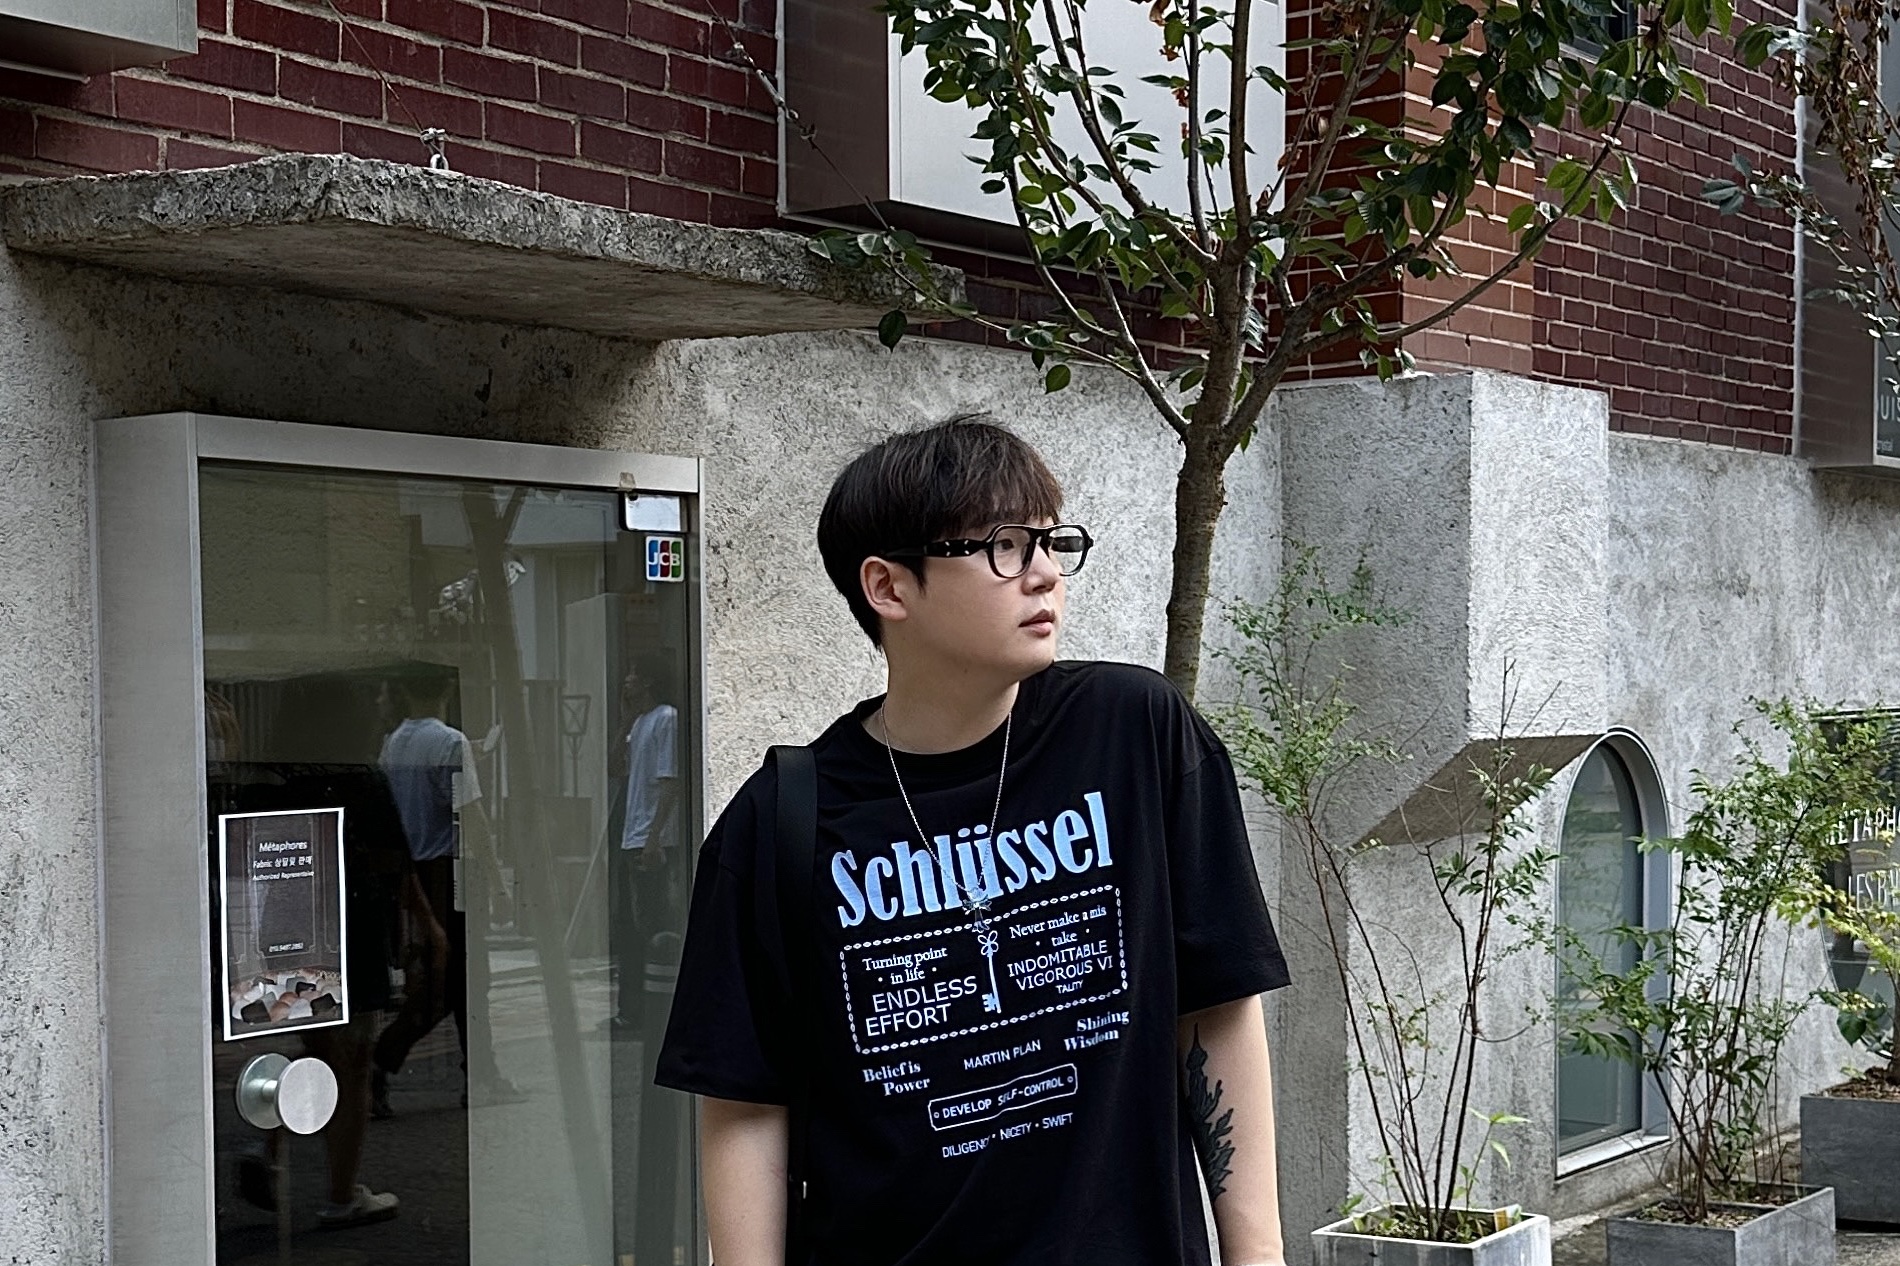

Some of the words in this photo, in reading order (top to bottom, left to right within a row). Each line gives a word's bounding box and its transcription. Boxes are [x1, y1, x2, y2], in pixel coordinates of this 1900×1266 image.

[648, 551, 681, 566] JCB
[831, 791, 1113, 928] Schlüssel
[1009, 919, 1046, 939] Never
[1047, 911, 1080, 930] make
[1082, 911, 1089, 921] a
[1089, 904, 1107, 919] mis
[1051, 931, 1078, 947] take
[861, 953, 914, 971] Turning
[914, 947, 948, 968] point
[1006, 939, 1108, 978] INDOMITABLE
[890, 972, 904, 985] in
[904, 966, 926, 983] life
[1016, 959, 1093, 991] VIGOROUS
[1097, 955, 1113, 971] VI
[872, 975, 978, 1013] ENDLESS
[1055, 979, 1084, 994] TALITY
[865, 1002, 952, 1037] EFFORT
[1076, 1011, 1130, 1032] Shining
[1063, 1029, 1120, 1051] Wisdom
[963, 1049, 1011, 1070] MARTIN
[1012, 1039, 1042, 1059] PLAN
[862, 1061, 907, 1083] Belief
[908, 1060, 921, 1074] is
[882, 1078, 930, 1097] Power
[942, 1098, 992, 1119] DEVELOP
[1000, 1121, 1032, 1141] NICETY
[1041, 1112, 1074, 1129] SWIFT
